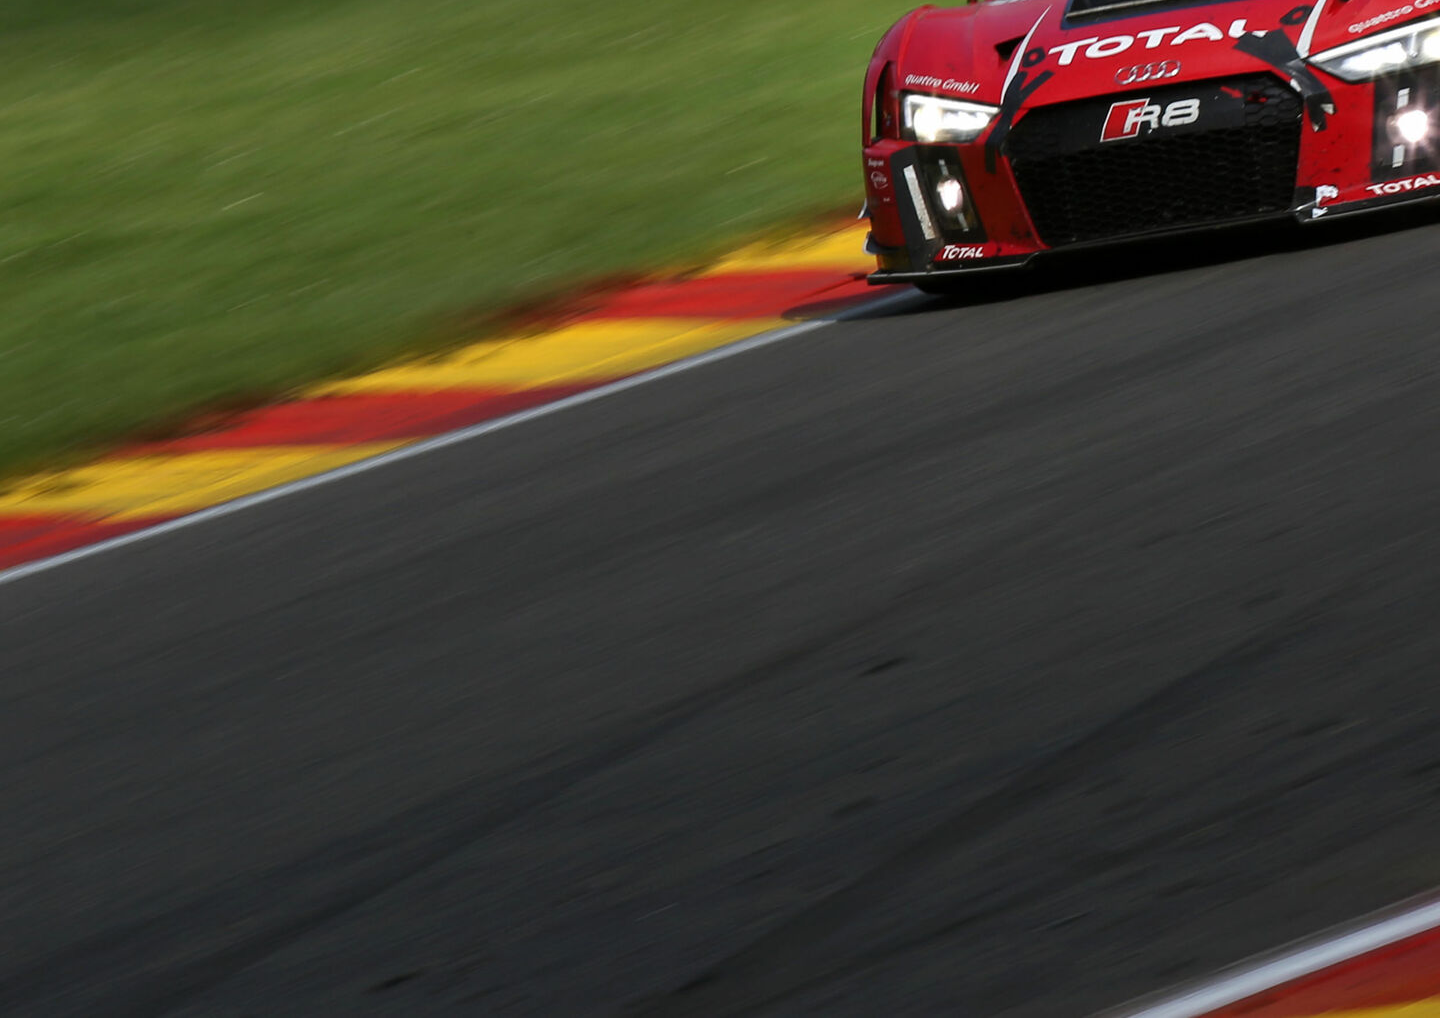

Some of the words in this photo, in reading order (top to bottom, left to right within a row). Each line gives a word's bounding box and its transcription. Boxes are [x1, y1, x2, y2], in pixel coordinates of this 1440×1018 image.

[1048, 19, 1269, 66] TOTAL
[905, 74, 942, 88] quattro
[941, 79, 980, 94] GmbH
[1122, 97, 1200, 134] R8
[942, 244, 984, 260] TOTAL
